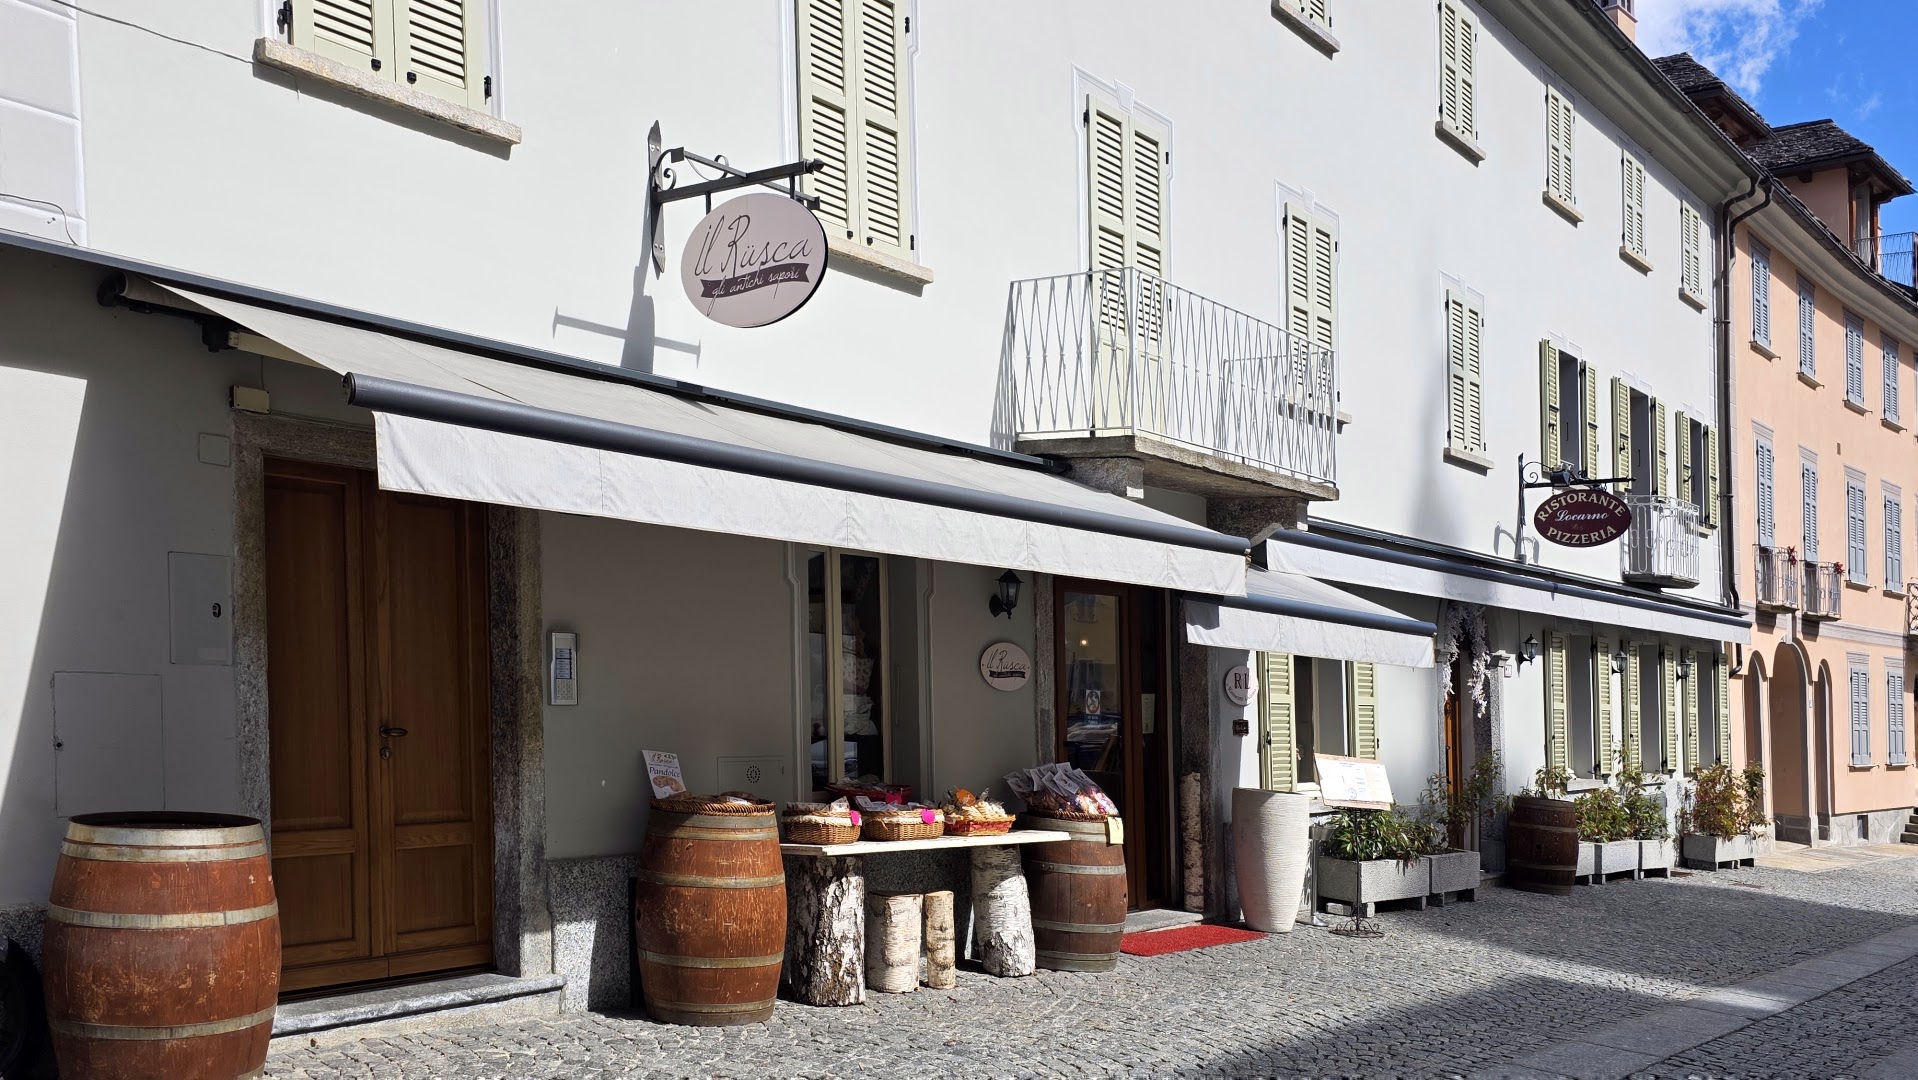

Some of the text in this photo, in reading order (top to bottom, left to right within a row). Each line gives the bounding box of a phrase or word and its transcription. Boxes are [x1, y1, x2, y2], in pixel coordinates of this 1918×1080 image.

[694, 215, 725, 276] il
[707, 266, 800, 317] gli antichi sapori
[1537, 492, 1626, 522] RISTORANTE
[1555, 510, 1609, 522] Locarno
[1546, 525, 1617, 544] PIZZERIA
[649, 766, 681, 778] Pandolce
